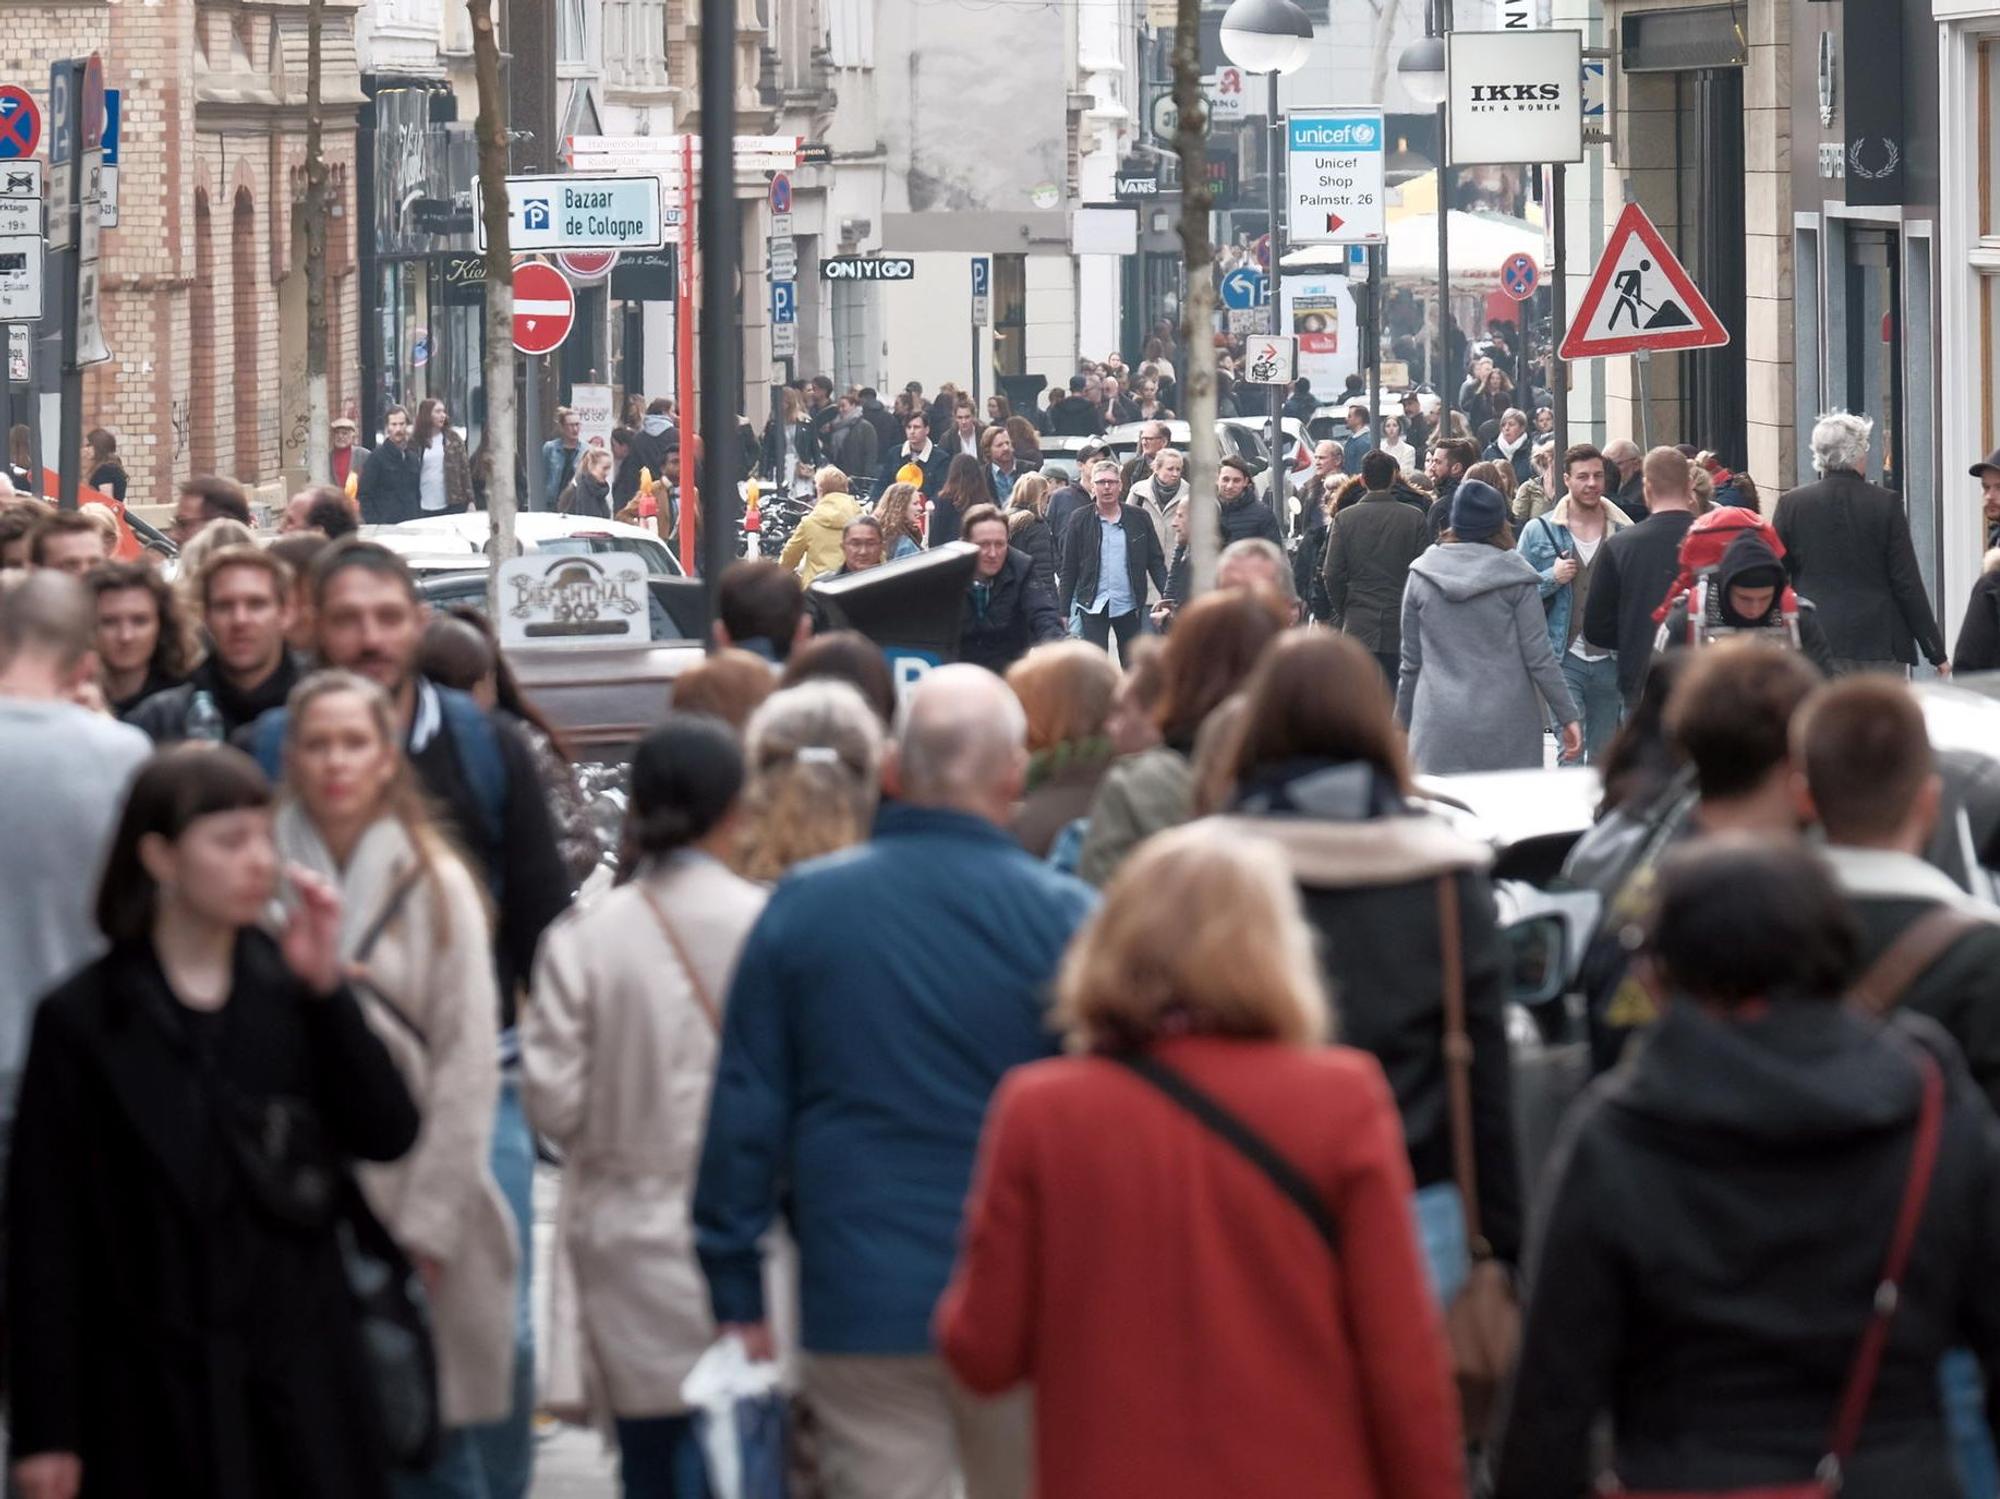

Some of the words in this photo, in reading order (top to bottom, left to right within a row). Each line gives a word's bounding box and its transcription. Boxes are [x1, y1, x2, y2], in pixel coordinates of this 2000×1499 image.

[1471, 83, 1560, 101] IKKS
[1503, 104, 1509, 112] &
[1518, 103, 1560, 111] WOMEN
[1295, 125, 1351, 143] unicef
[1315, 158, 1357, 169] Unicef
[1118, 178, 1157, 193] VANS
[1319, 176, 1353, 188] Shop
[565, 188, 614, 208] Bazaar
[1300, 194, 1352, 205] Palmstr.
[1358, 194, 1373, 205] 26
[531, 208, 543, 228] P
[566, 217, 582, 235] de
[589, 216, 643, 240] Cologne
[974, 262, 984, 294] P
[775, 288, 787, 322] P
[554, 603, 599, 620] 1905
